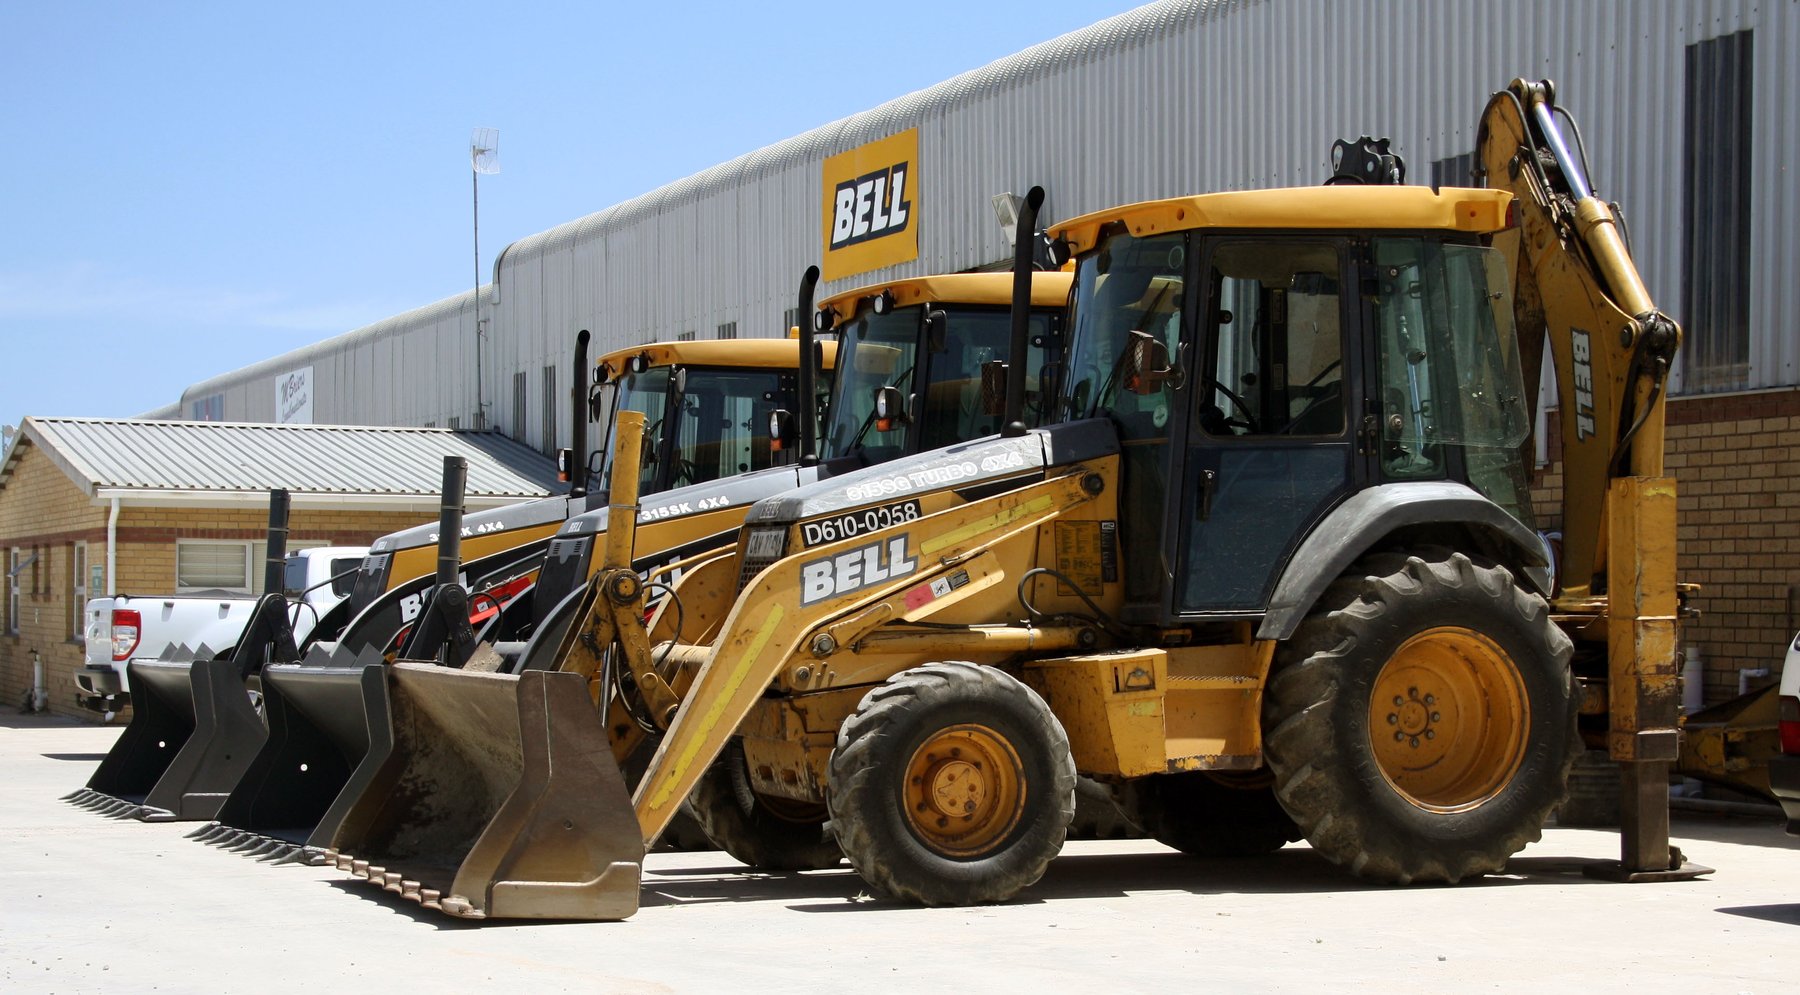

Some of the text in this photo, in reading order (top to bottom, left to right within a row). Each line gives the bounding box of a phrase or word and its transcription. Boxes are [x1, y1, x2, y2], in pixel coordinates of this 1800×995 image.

[832, 170, 907, 245] BELL
[1571, 330, 1595, 441] BELL
[846, 450, 1024, 501] 315SG TURBO 4X4
[477, 520, 505, 533] 4X4
[640, 495, 730, 521] 315SK 4X4
[803, 537, 915, 604] BELL
